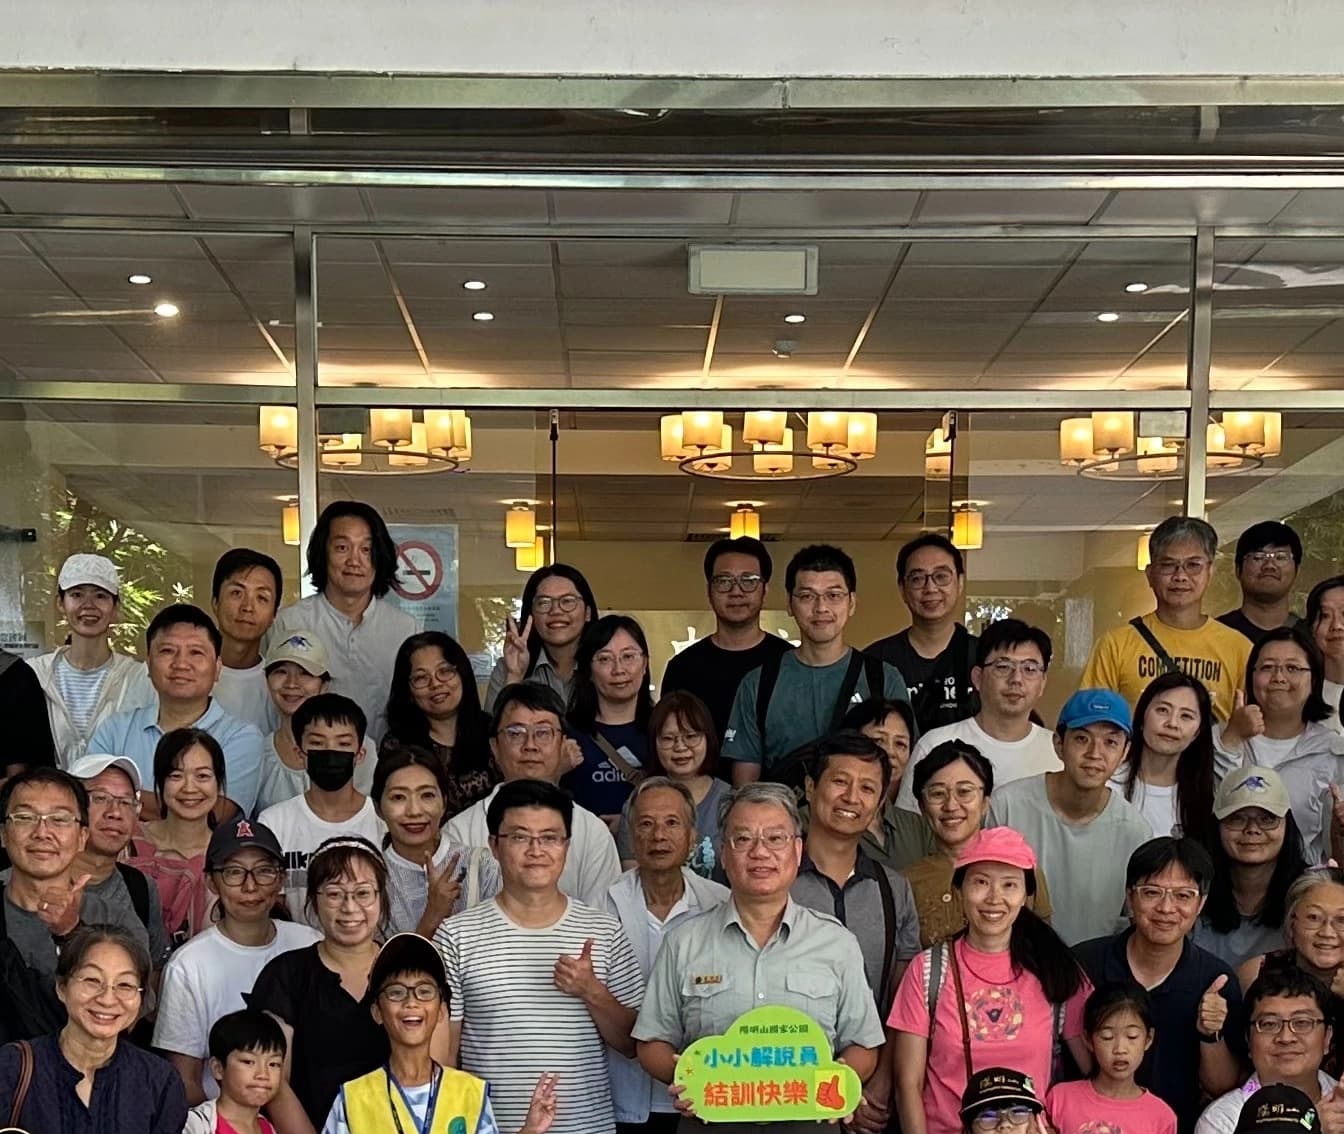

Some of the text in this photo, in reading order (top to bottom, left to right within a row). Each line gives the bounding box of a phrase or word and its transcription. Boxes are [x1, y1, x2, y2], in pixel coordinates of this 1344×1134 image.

[739, 1024, 809, 1035] 陽明山國家公園
[704, 1046, 818, 1068] 小小解說員
[704, 1080, 808, 1107] 結訓快樂
